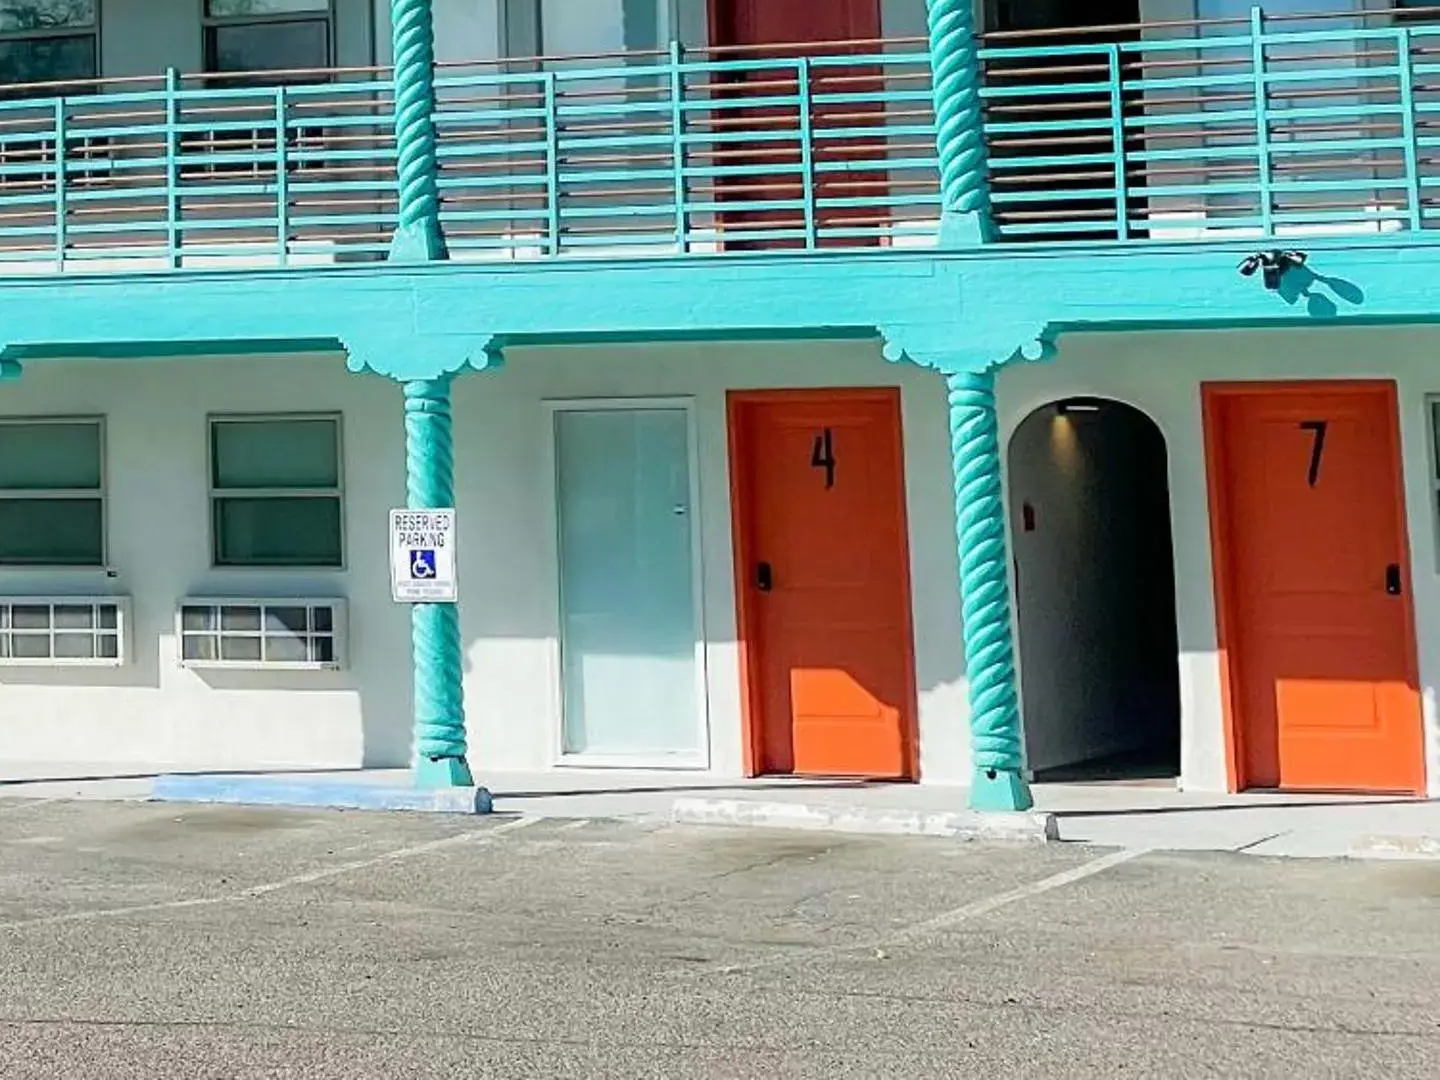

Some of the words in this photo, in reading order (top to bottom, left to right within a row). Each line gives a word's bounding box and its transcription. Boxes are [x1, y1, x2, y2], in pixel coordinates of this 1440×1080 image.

[811, 427, 835, 491] 4
[1298, 421, 1327, 488] 7
[395, 514, 450, 531] RESERVED
[399, 532, 445, 548] PARKING
